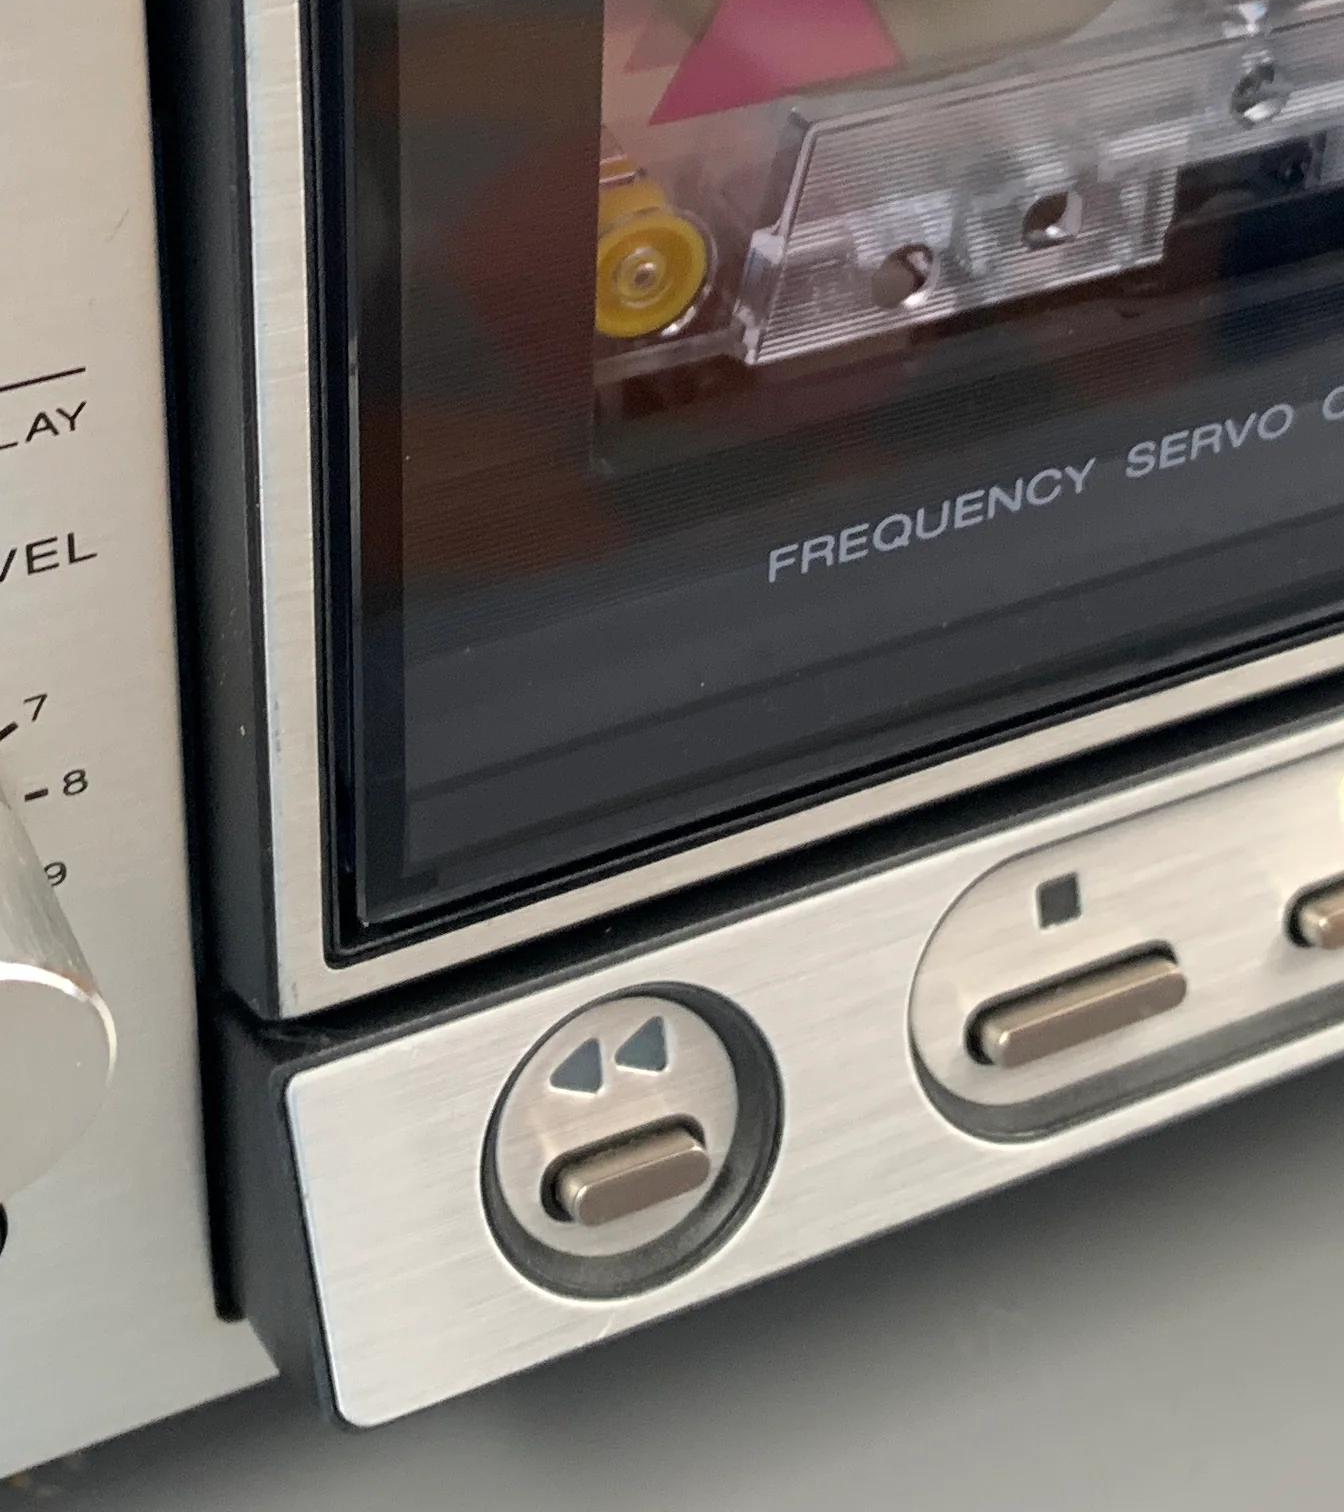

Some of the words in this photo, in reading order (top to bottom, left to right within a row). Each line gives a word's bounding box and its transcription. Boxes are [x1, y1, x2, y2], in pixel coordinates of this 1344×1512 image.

[768, 457, 1096, 583] FREQUENCY
[1124, 403, 1295, 479] SERVO
[23, 693, 50, 724] 7
[62, 769, 89, 797] 8
